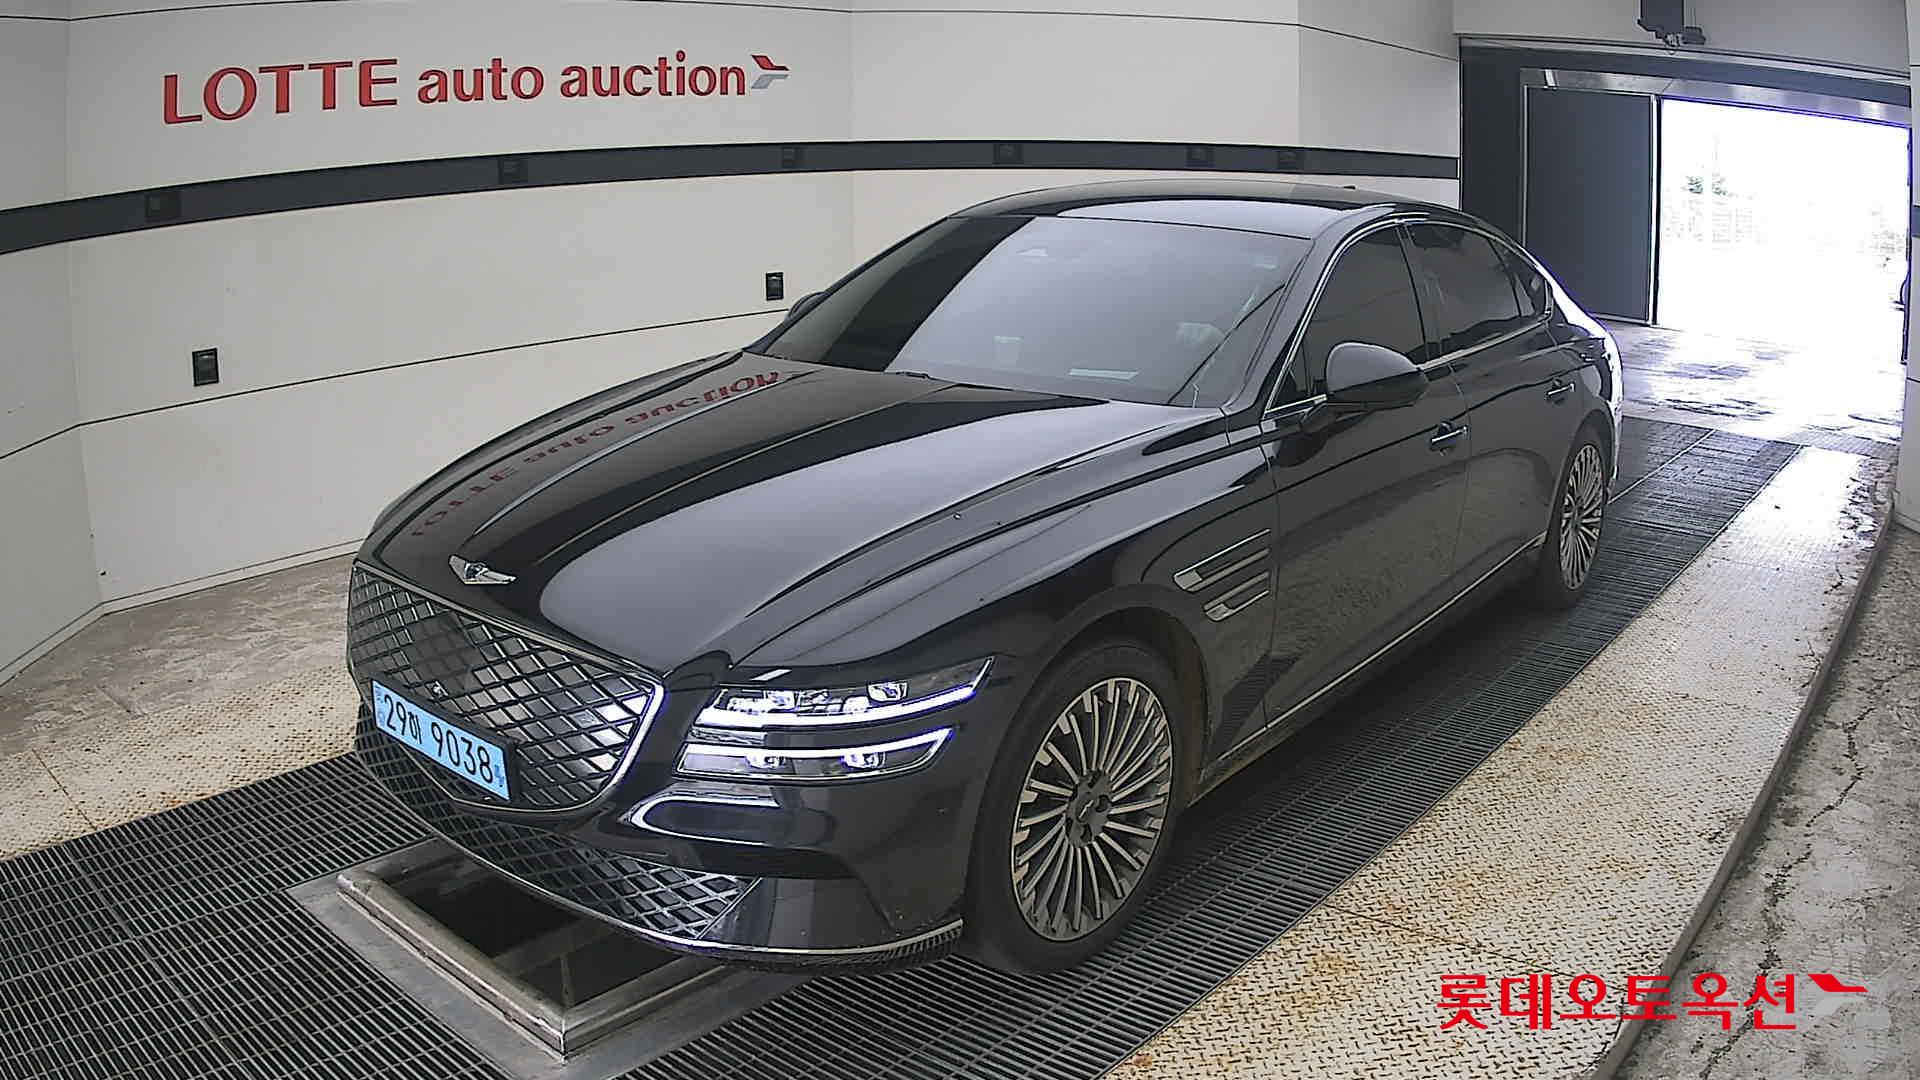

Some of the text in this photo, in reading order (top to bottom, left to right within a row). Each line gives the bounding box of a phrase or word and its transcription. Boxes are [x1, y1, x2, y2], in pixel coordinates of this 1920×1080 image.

[163, 50, 747, 125] LOTTE auto auction
[431, 722, 493, 784] 9038
